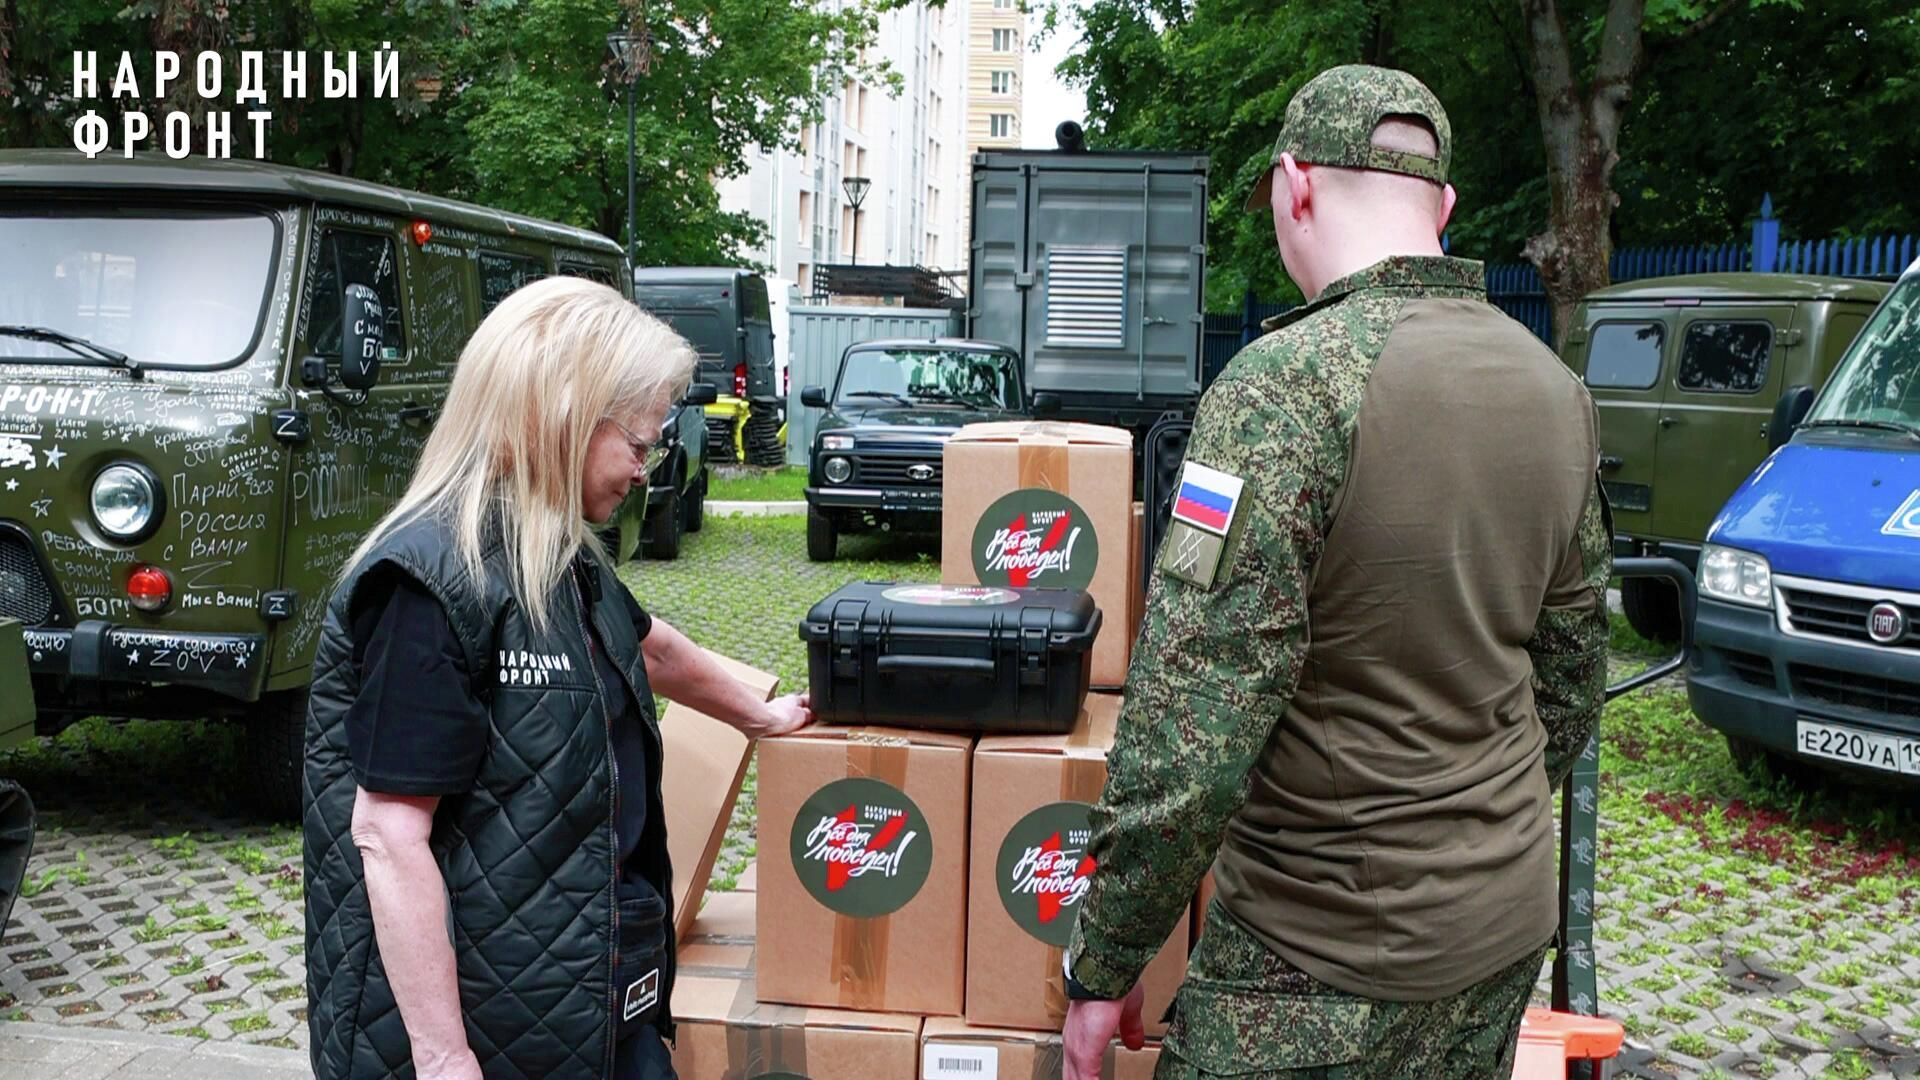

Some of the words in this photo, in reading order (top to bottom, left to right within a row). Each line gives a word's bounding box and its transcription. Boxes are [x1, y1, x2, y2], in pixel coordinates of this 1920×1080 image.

[76, 597, 131, 618] БОГ!
[1873, 614, 1895, 633] FIAT
[499, 650, 571, 671] НАРОДНЫЙ
[499, 668, 549, 685] ФРОНТ
